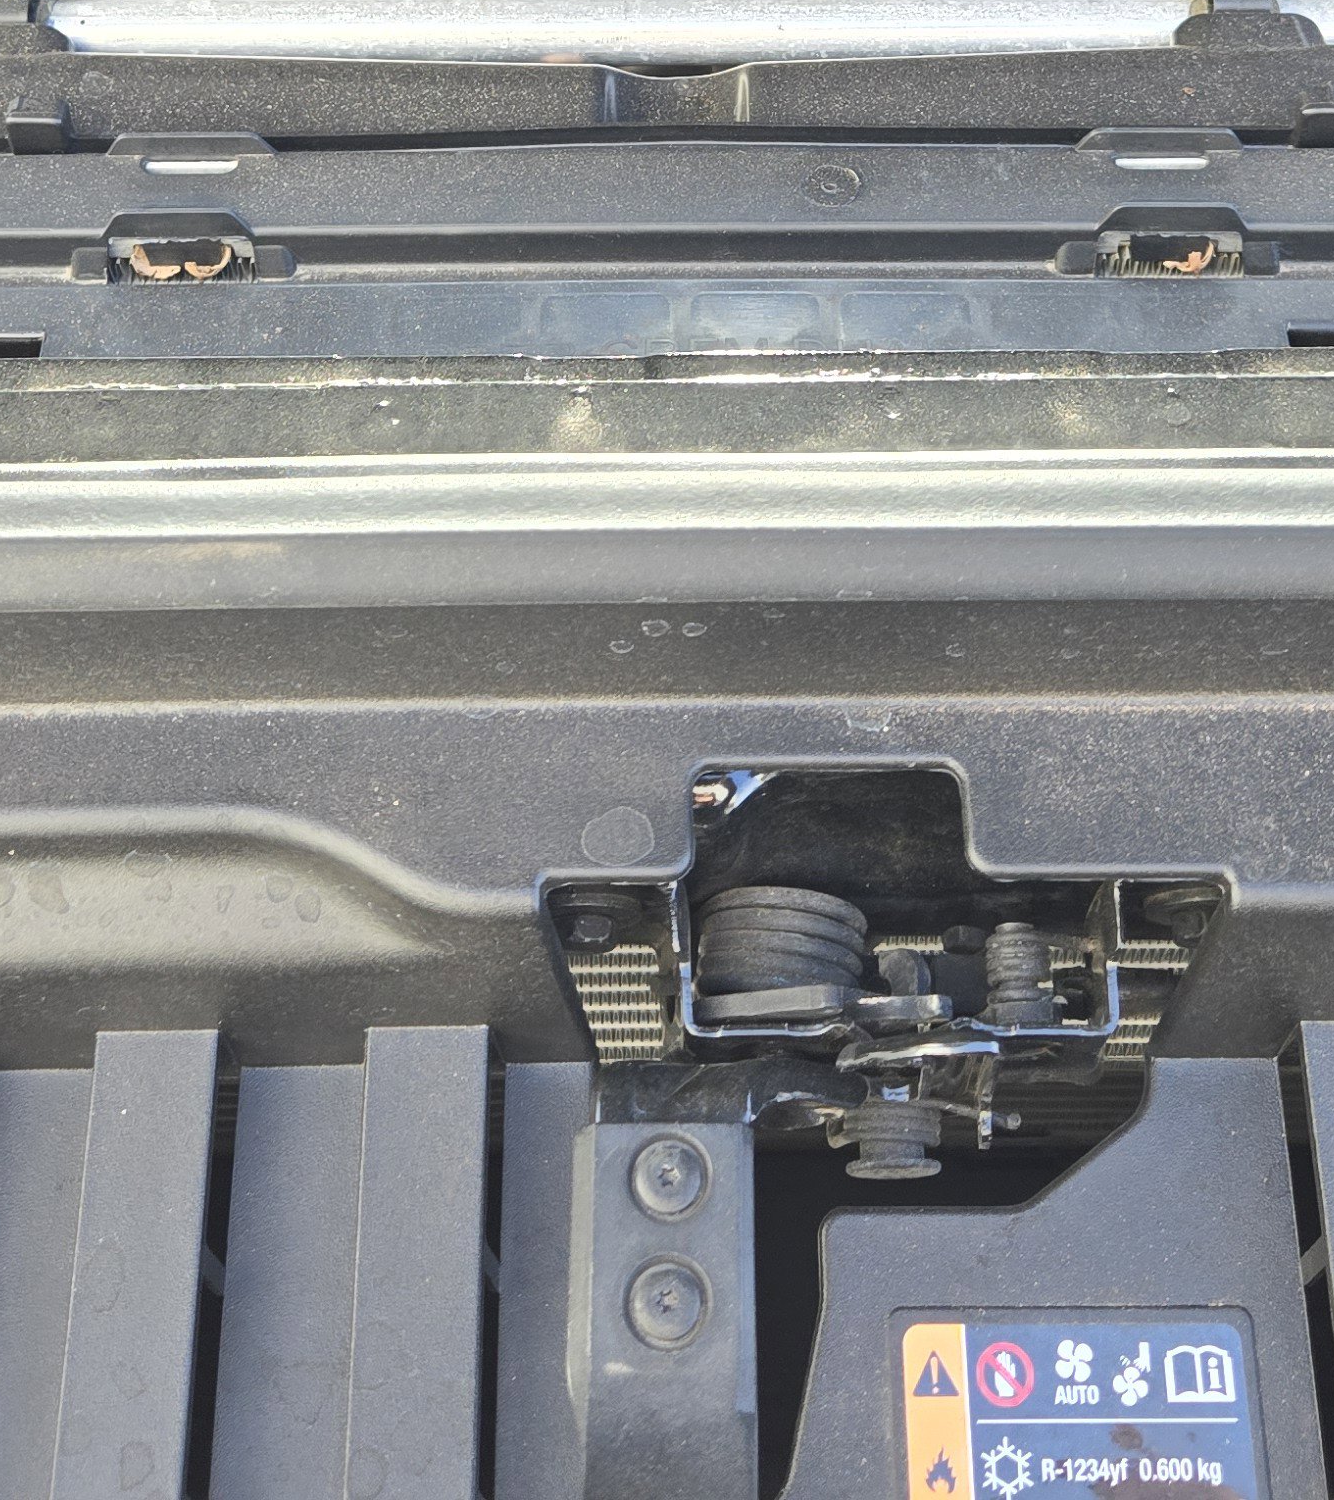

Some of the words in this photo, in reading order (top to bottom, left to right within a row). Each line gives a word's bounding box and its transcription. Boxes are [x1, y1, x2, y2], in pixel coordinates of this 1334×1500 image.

[1054, 1385, 1100, 1405] AUTO
[1041, 1457, 1128, 1486] R-1234yf
[1139, 1458, 1193, 1483] 0.600
[1197, 1458, 1223, 1485] kg
